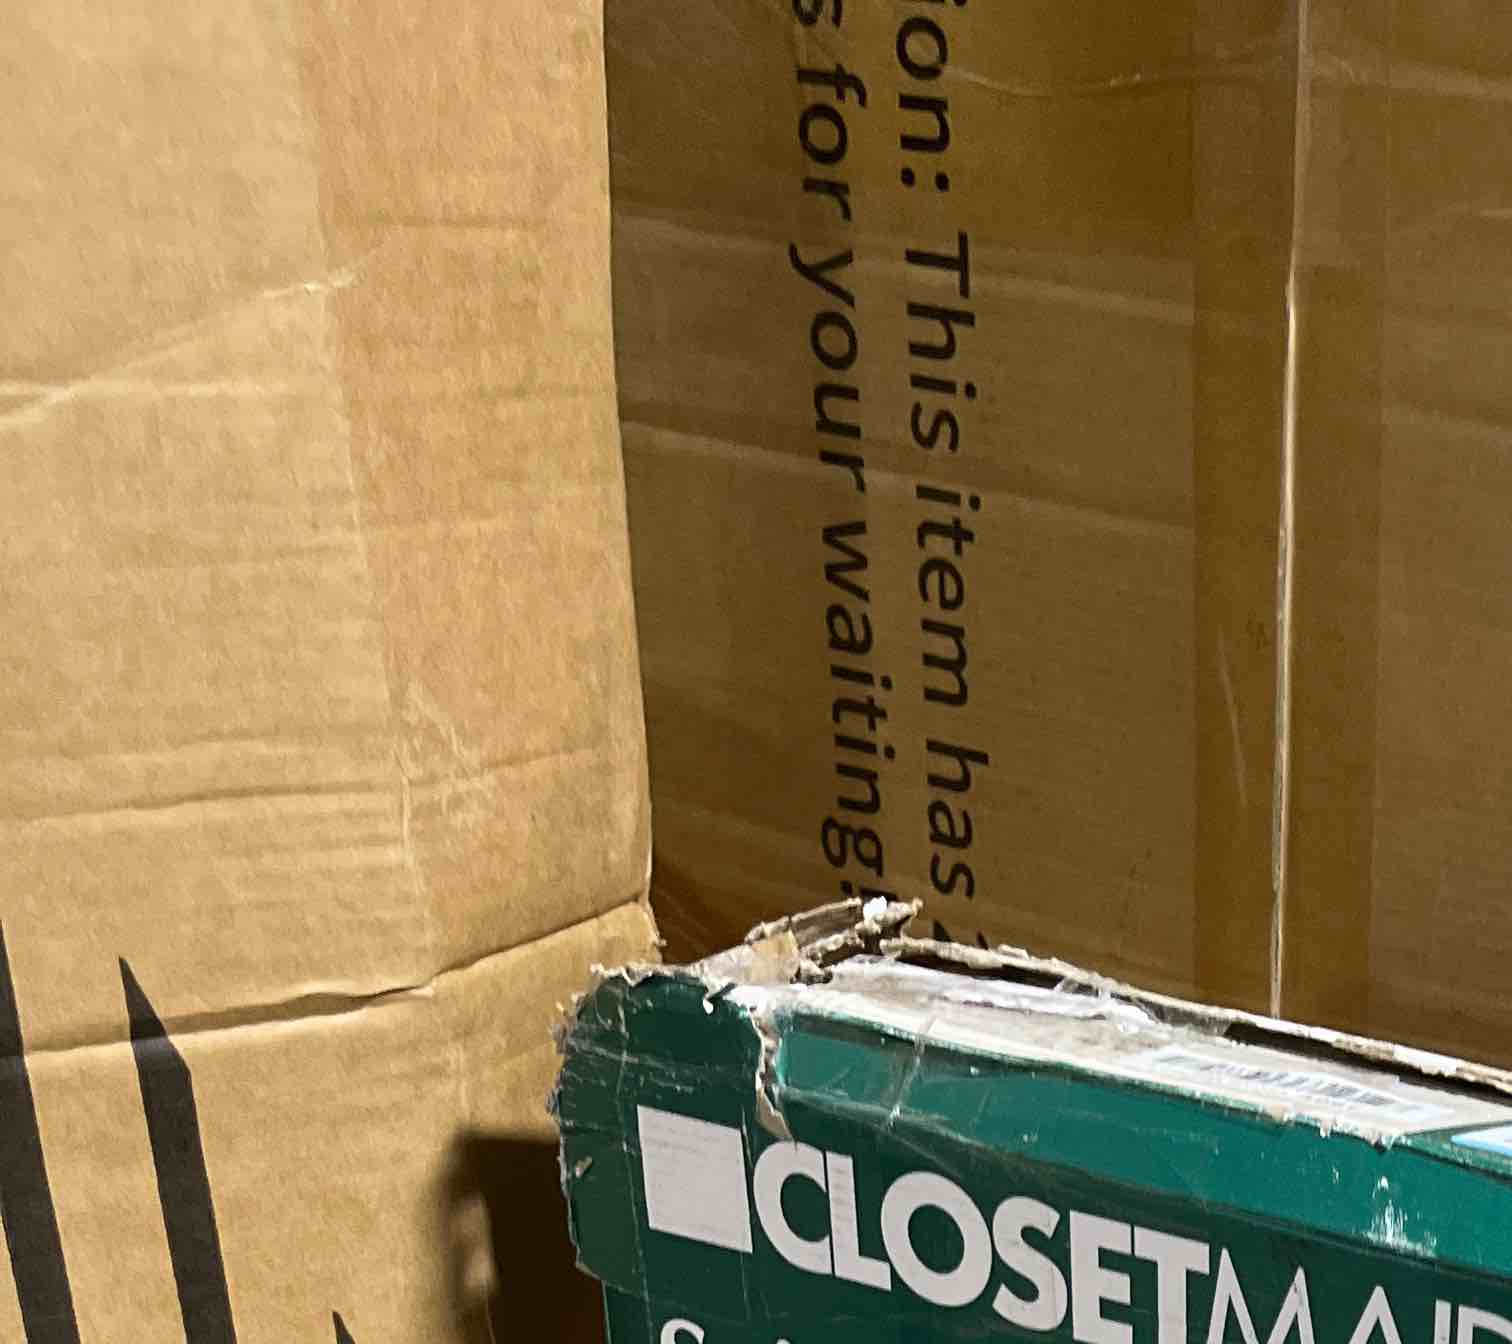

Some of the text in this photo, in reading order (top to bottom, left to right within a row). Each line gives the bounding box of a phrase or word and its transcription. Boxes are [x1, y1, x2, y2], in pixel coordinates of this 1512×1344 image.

[794, 64, 867, 222] for
[788, 242, 867, 494] your
[904, 229, 976, 452] This
[915, 484, 980, 707] item
[927, 737, 989, 899] has
